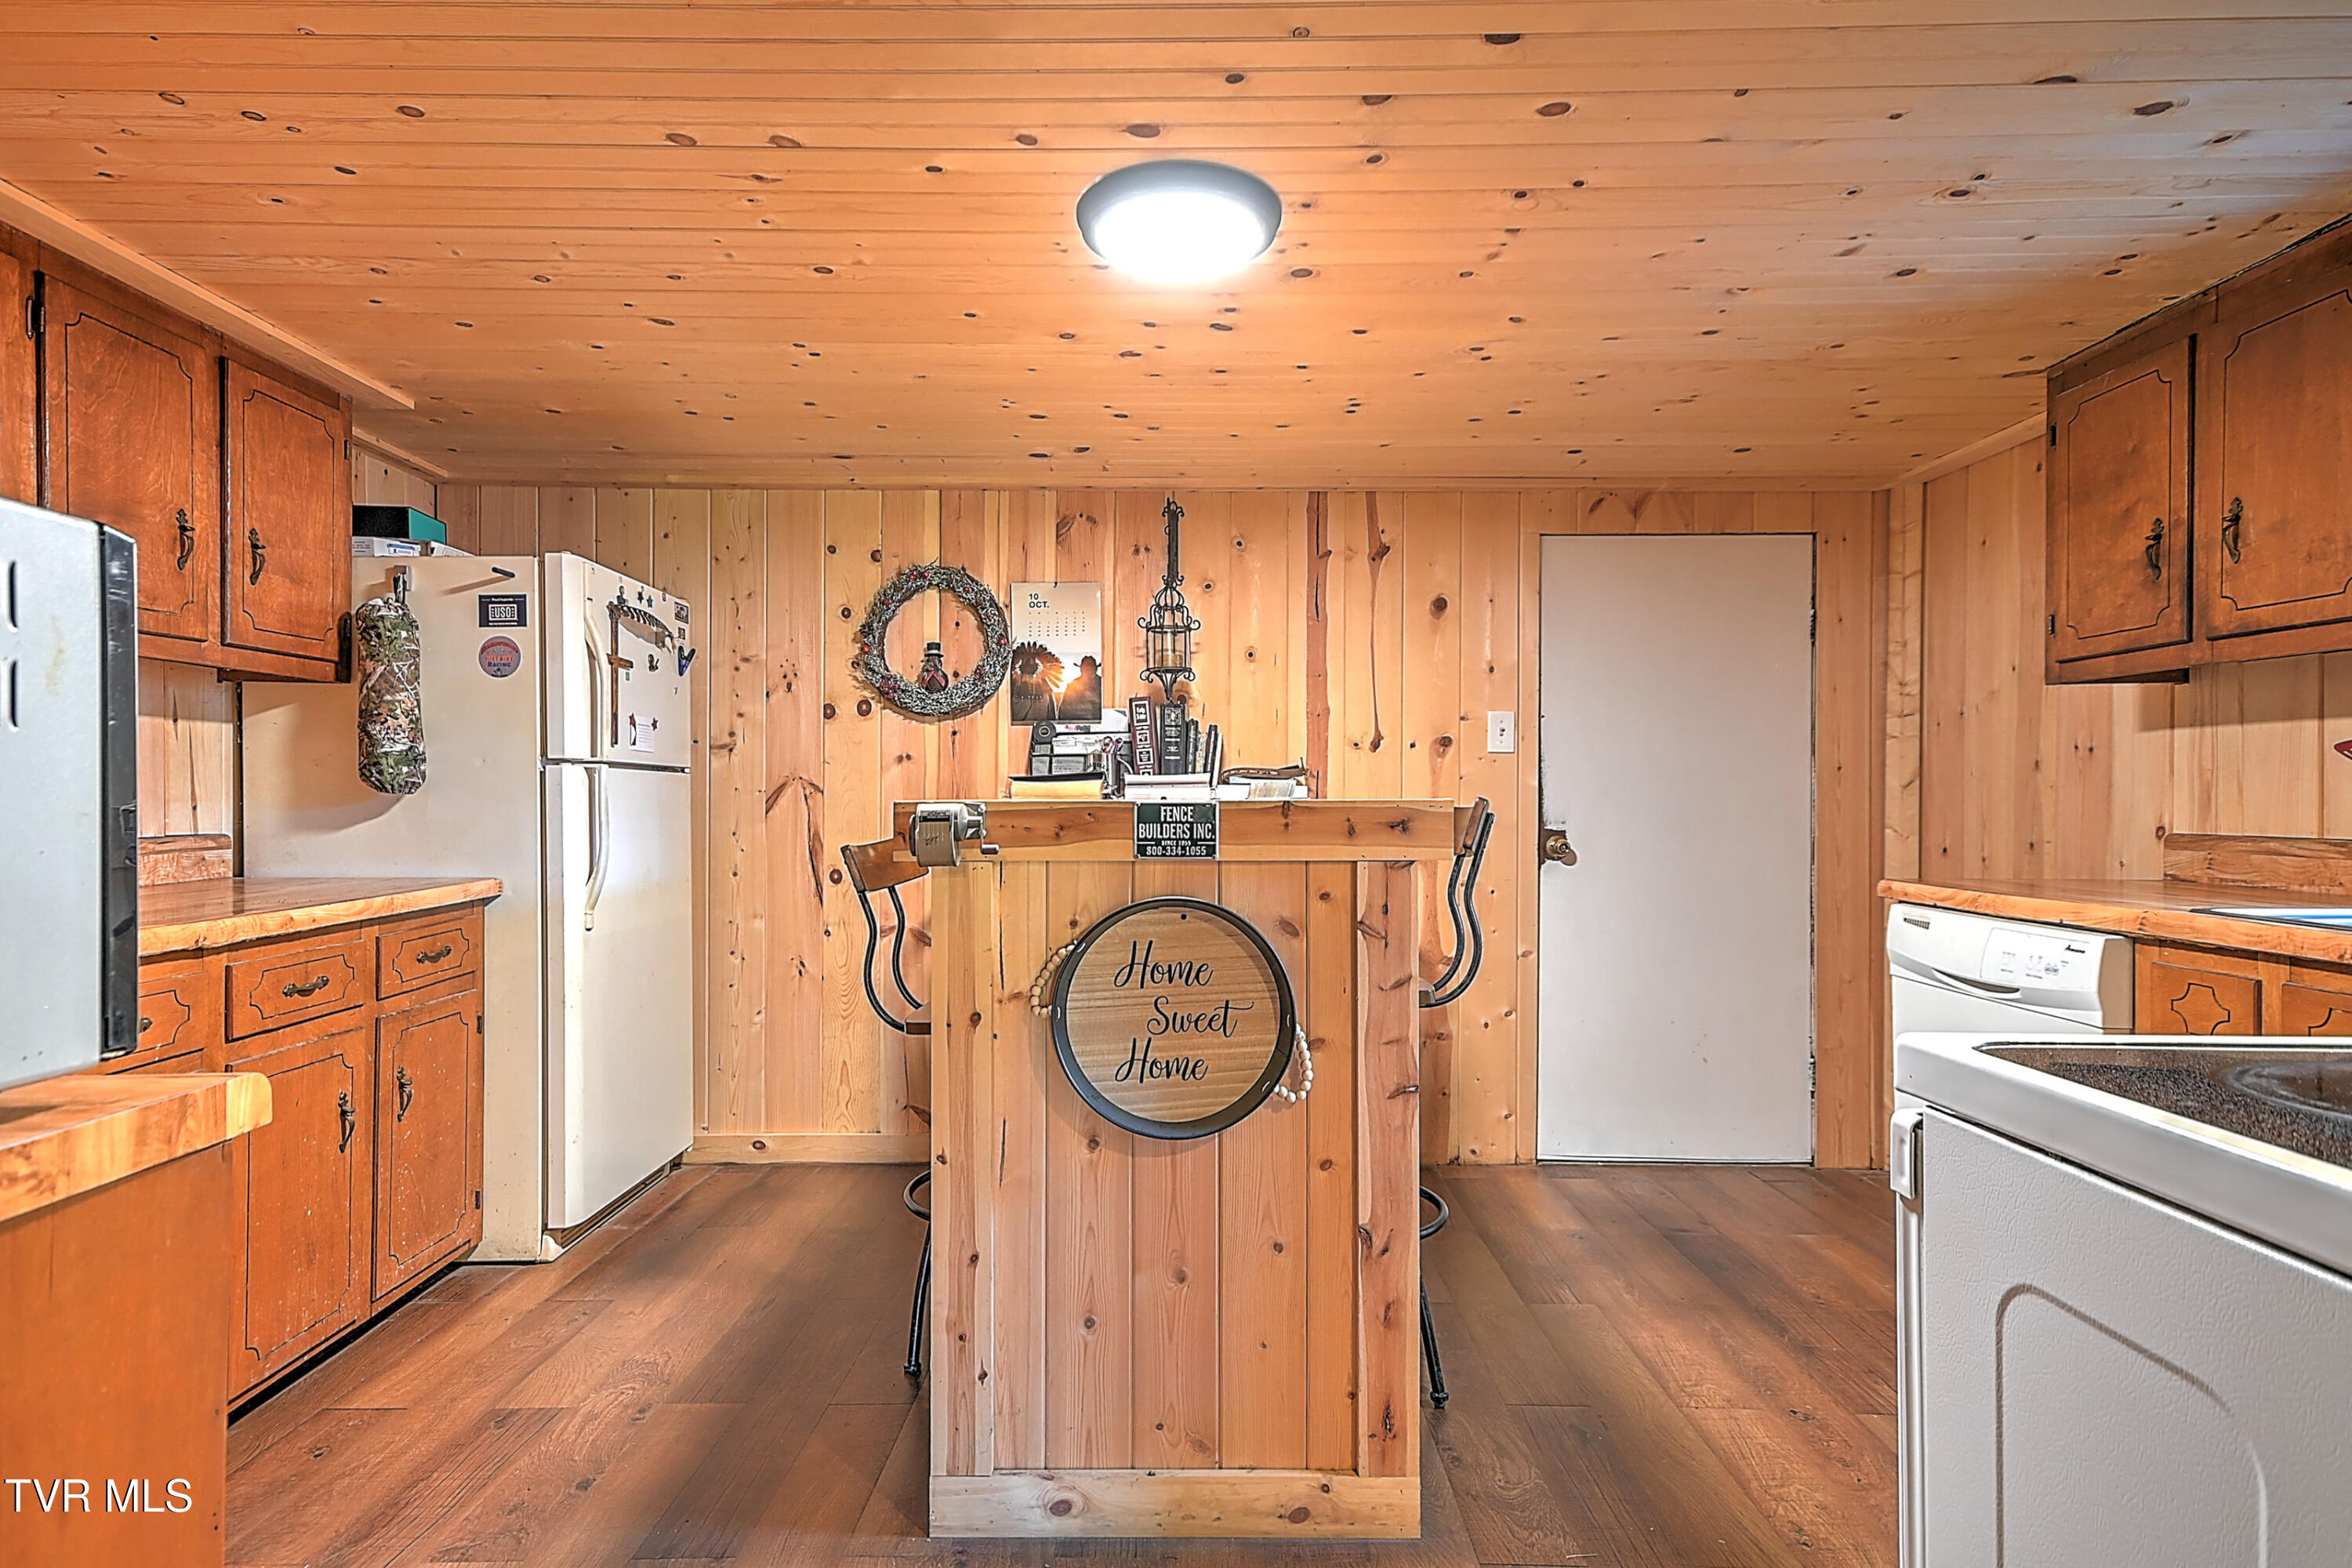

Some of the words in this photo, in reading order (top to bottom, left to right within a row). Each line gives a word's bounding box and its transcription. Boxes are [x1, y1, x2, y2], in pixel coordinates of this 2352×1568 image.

[495, 607, 511, 618] USO
[1160, 806, 1194, 822] FENCE
[1138, 823, 1190, 839] BUILDERS
[1193, 823, 1215, 839] INC.
[1145, 846, 1207, 855] 800-334-1055
[1113, 939, 1214, 989] Home
[1147, 996, 1254, 1038] Sweet
[1115, 1036, 1209, 1083] Home
